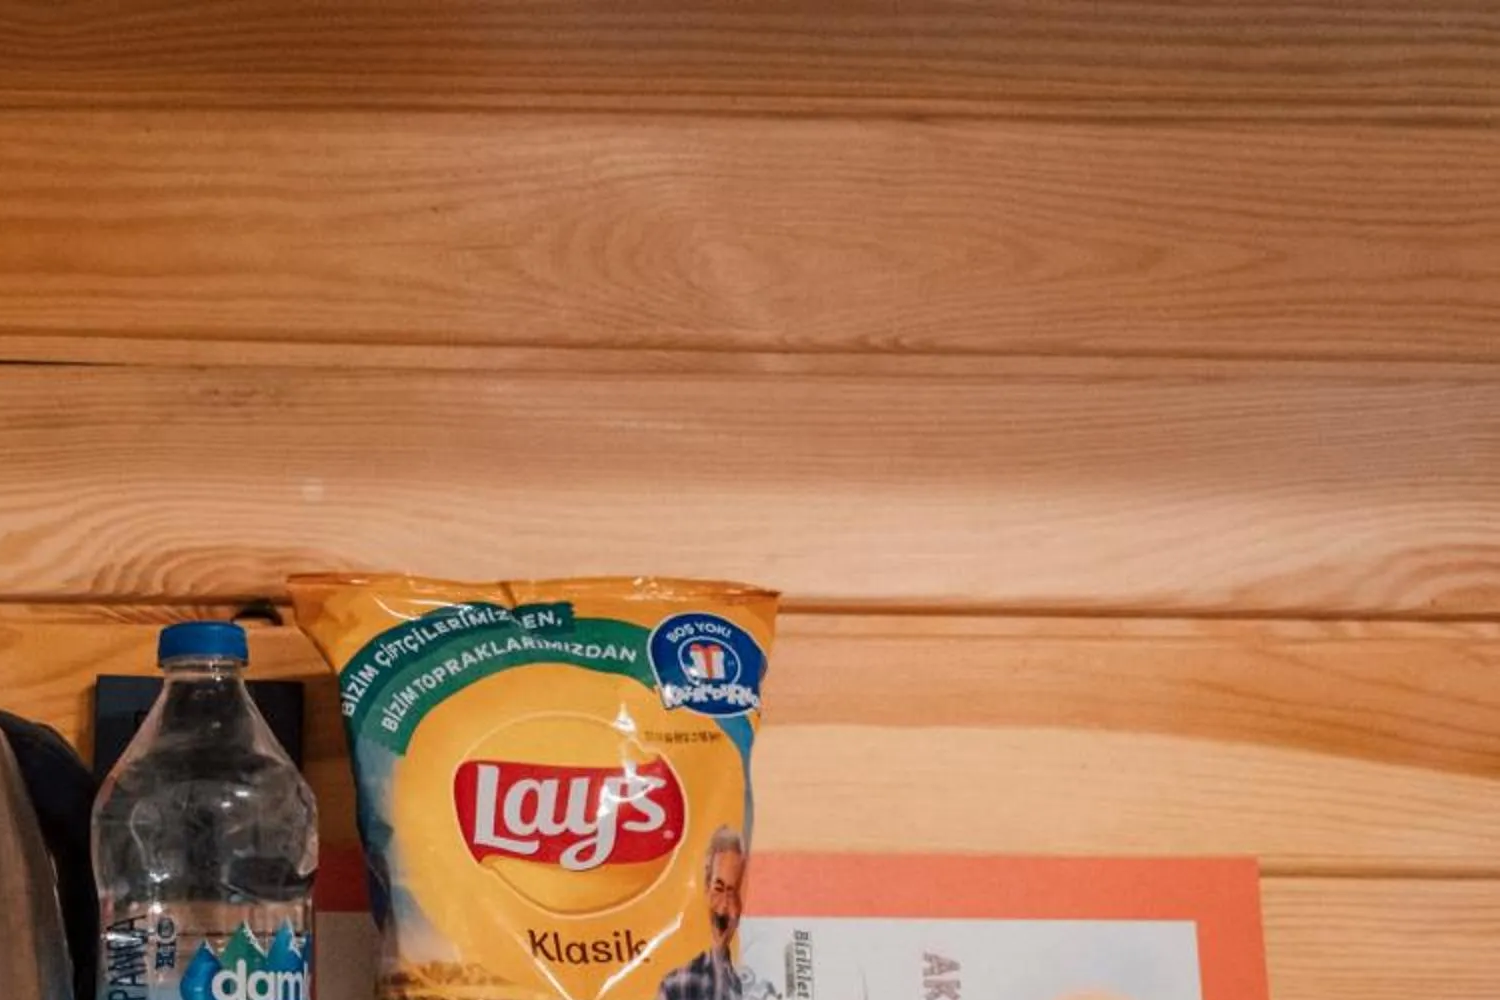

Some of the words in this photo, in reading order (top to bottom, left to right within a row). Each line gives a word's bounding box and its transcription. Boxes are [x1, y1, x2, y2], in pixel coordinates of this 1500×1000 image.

[341, 663, 380, 717] BİZİM
[373, 606, 563, 668] ÇİFTÇİLERİMİZEN,
[381, 686, 419, 732] BİZİM
[412, 636, 637, 693] TOPRAKLARIMIZDAN
[527, 928, 652, 965] Klasik
